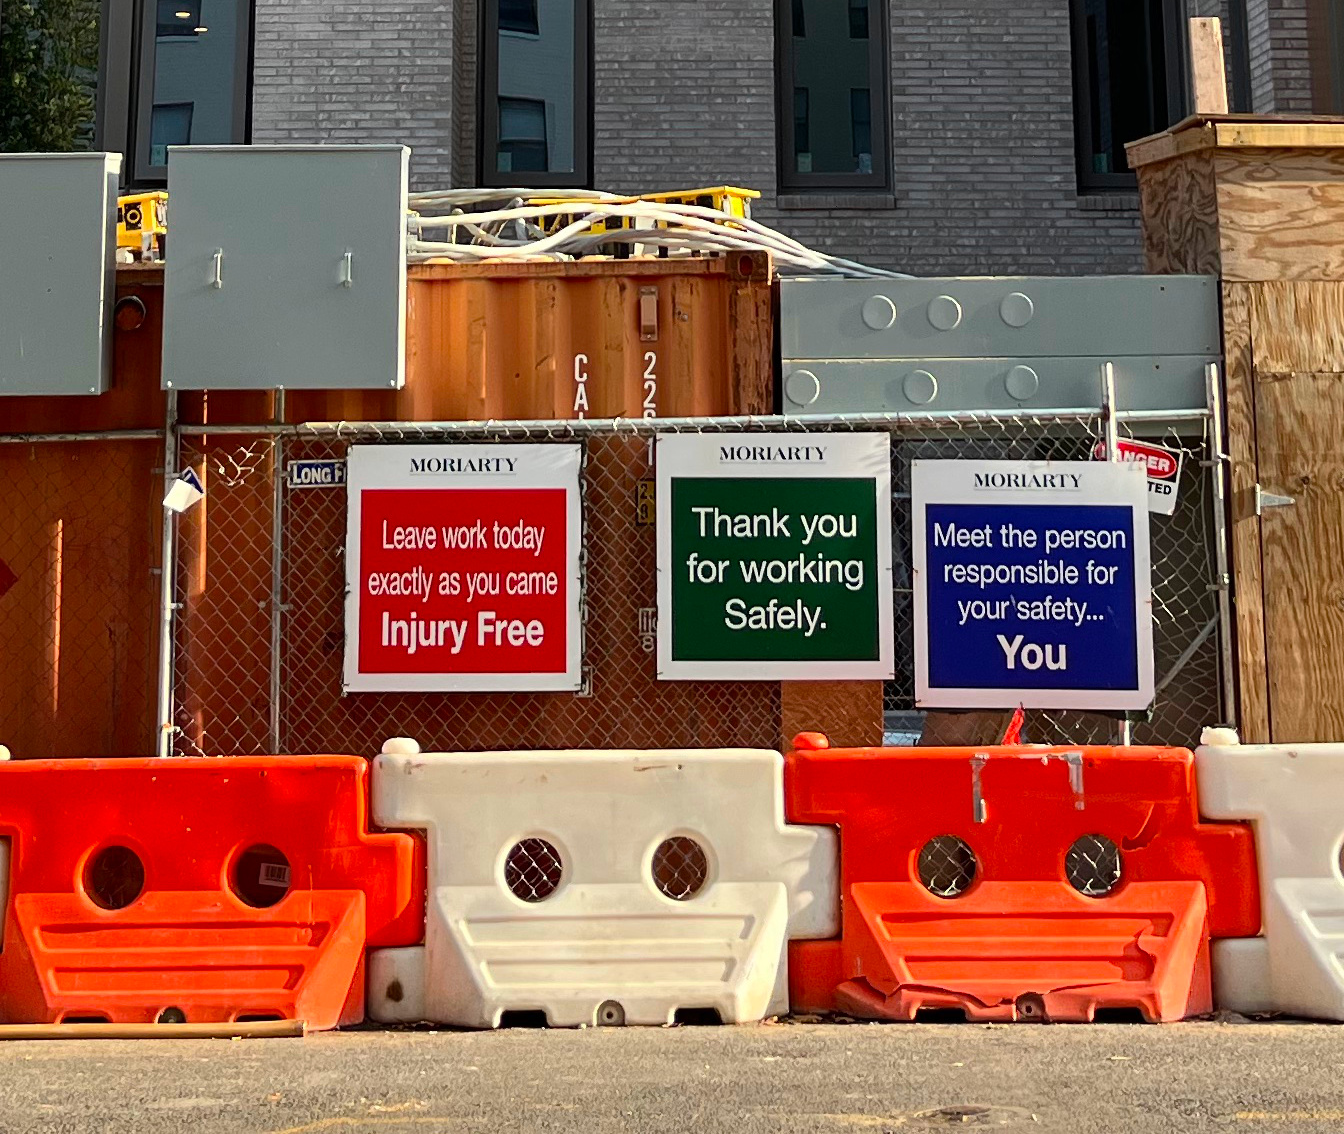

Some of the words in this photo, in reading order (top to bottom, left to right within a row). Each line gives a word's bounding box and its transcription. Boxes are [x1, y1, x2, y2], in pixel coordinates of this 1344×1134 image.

[409, 456, 518, 473] MORIARTY
[719, 446, 828, 461] MORIARTY
[292, 464, 332, 484] LONG
[974, 472, 1083, 489] MORIARTY
[382, 520, 437, 550] Leave
[441, 520, 488, 550] work
[493, 519, 545, 557] today
[692, 507, 790, 539] Thank
[800, 511, 858, 545] you
[934, 523, 993, 548] Meet
[998, 523, 1038, 548] the
[1044, 528, 1127, 555] person
[368, 565, 433, 603] exactly
[438, 575, 460, 596] as
[466, 574, 500, 602] you
[505, 573, 558, 596] came
[687, 552, 729, 584] for
[739, 553, 864, 591] working
[943, 559, 1079, 590] responsible
[1085, 561, 1118, 585] for
[724, 599, 828, 638] Safely.
[958, 601, 1009, 626] your
[1016, 596, 1105, 626] safety...
[381, 611, 468, 654] Injury
[476, 610, 545, 647] Free
[996, 634, 1068, 670] You
